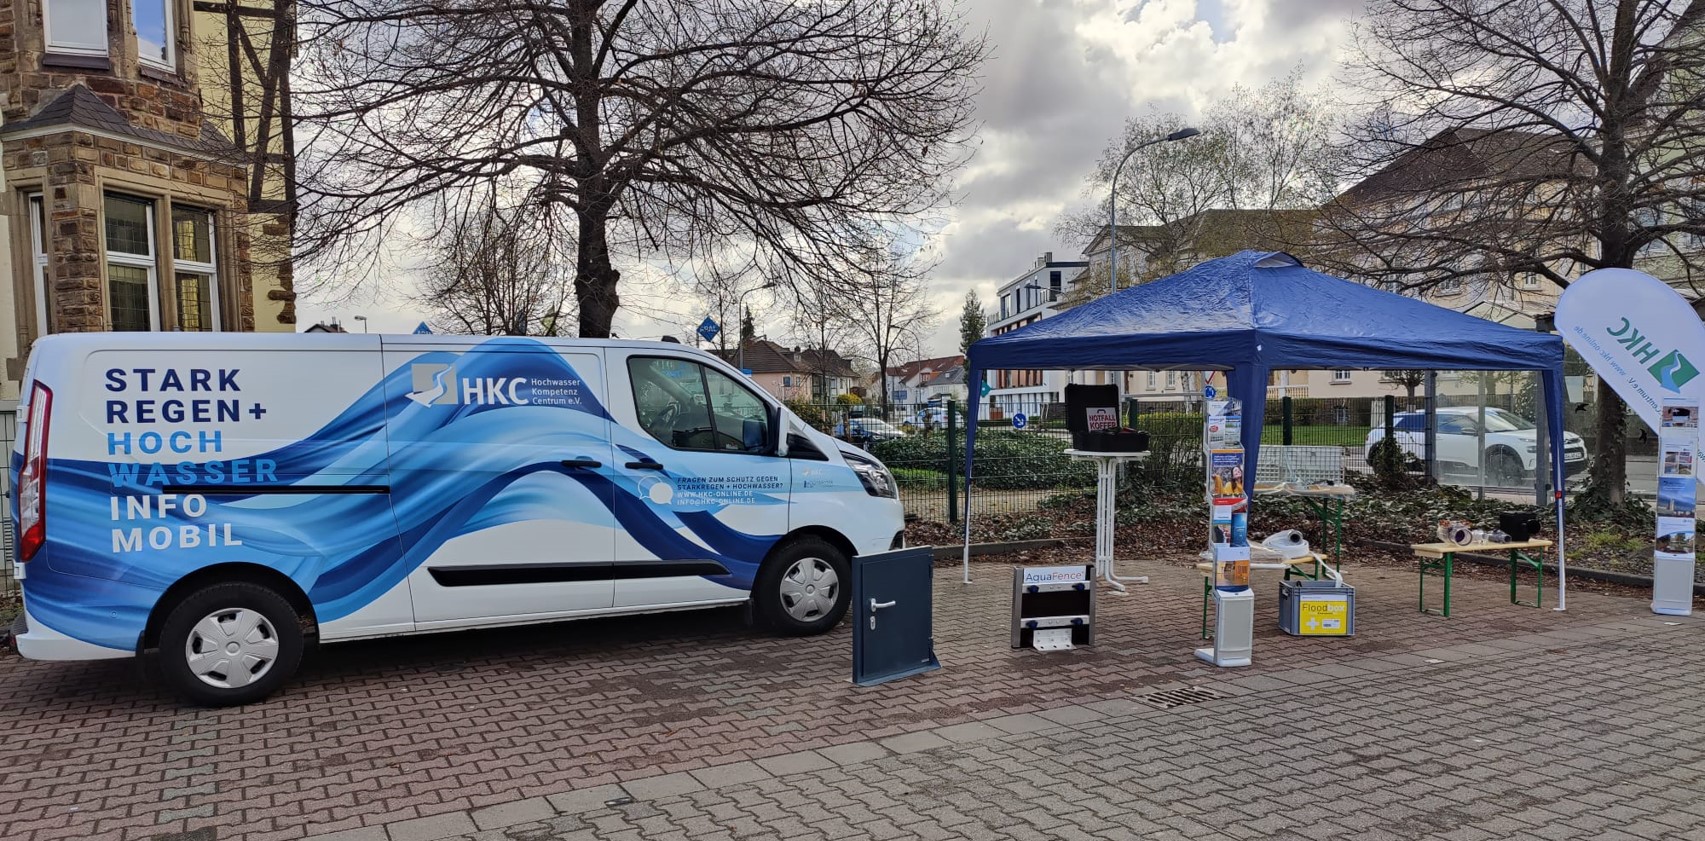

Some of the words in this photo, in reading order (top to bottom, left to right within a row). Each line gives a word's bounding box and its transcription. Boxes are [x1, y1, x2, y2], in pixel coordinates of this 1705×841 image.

[105, 368, 241, 392] STARK
[531, 378, 581, 387] Hochwasser
[463, 377, 529, 406] HKC
[532, 388, 578, 397] Kompetenz
[532, 397, 566, 406] Centrum
[568, 397, 582, 406] e.V.
[1089, 414, 1116, 422] NOTFALL
[107, 430, 222, 455] HOCH
[108, 458, 278, 488] WASSER
[677, 490, 753, 498] WWW.HKC-ONLINE.DE
[677, 498, 756, 506] INFO@HKC-ONLINE.DE
[110, 494, 207, 521] INFO
[111, 523, 243, 553] MOBIL
[1302, 603, 1344, 612] Floodbox
